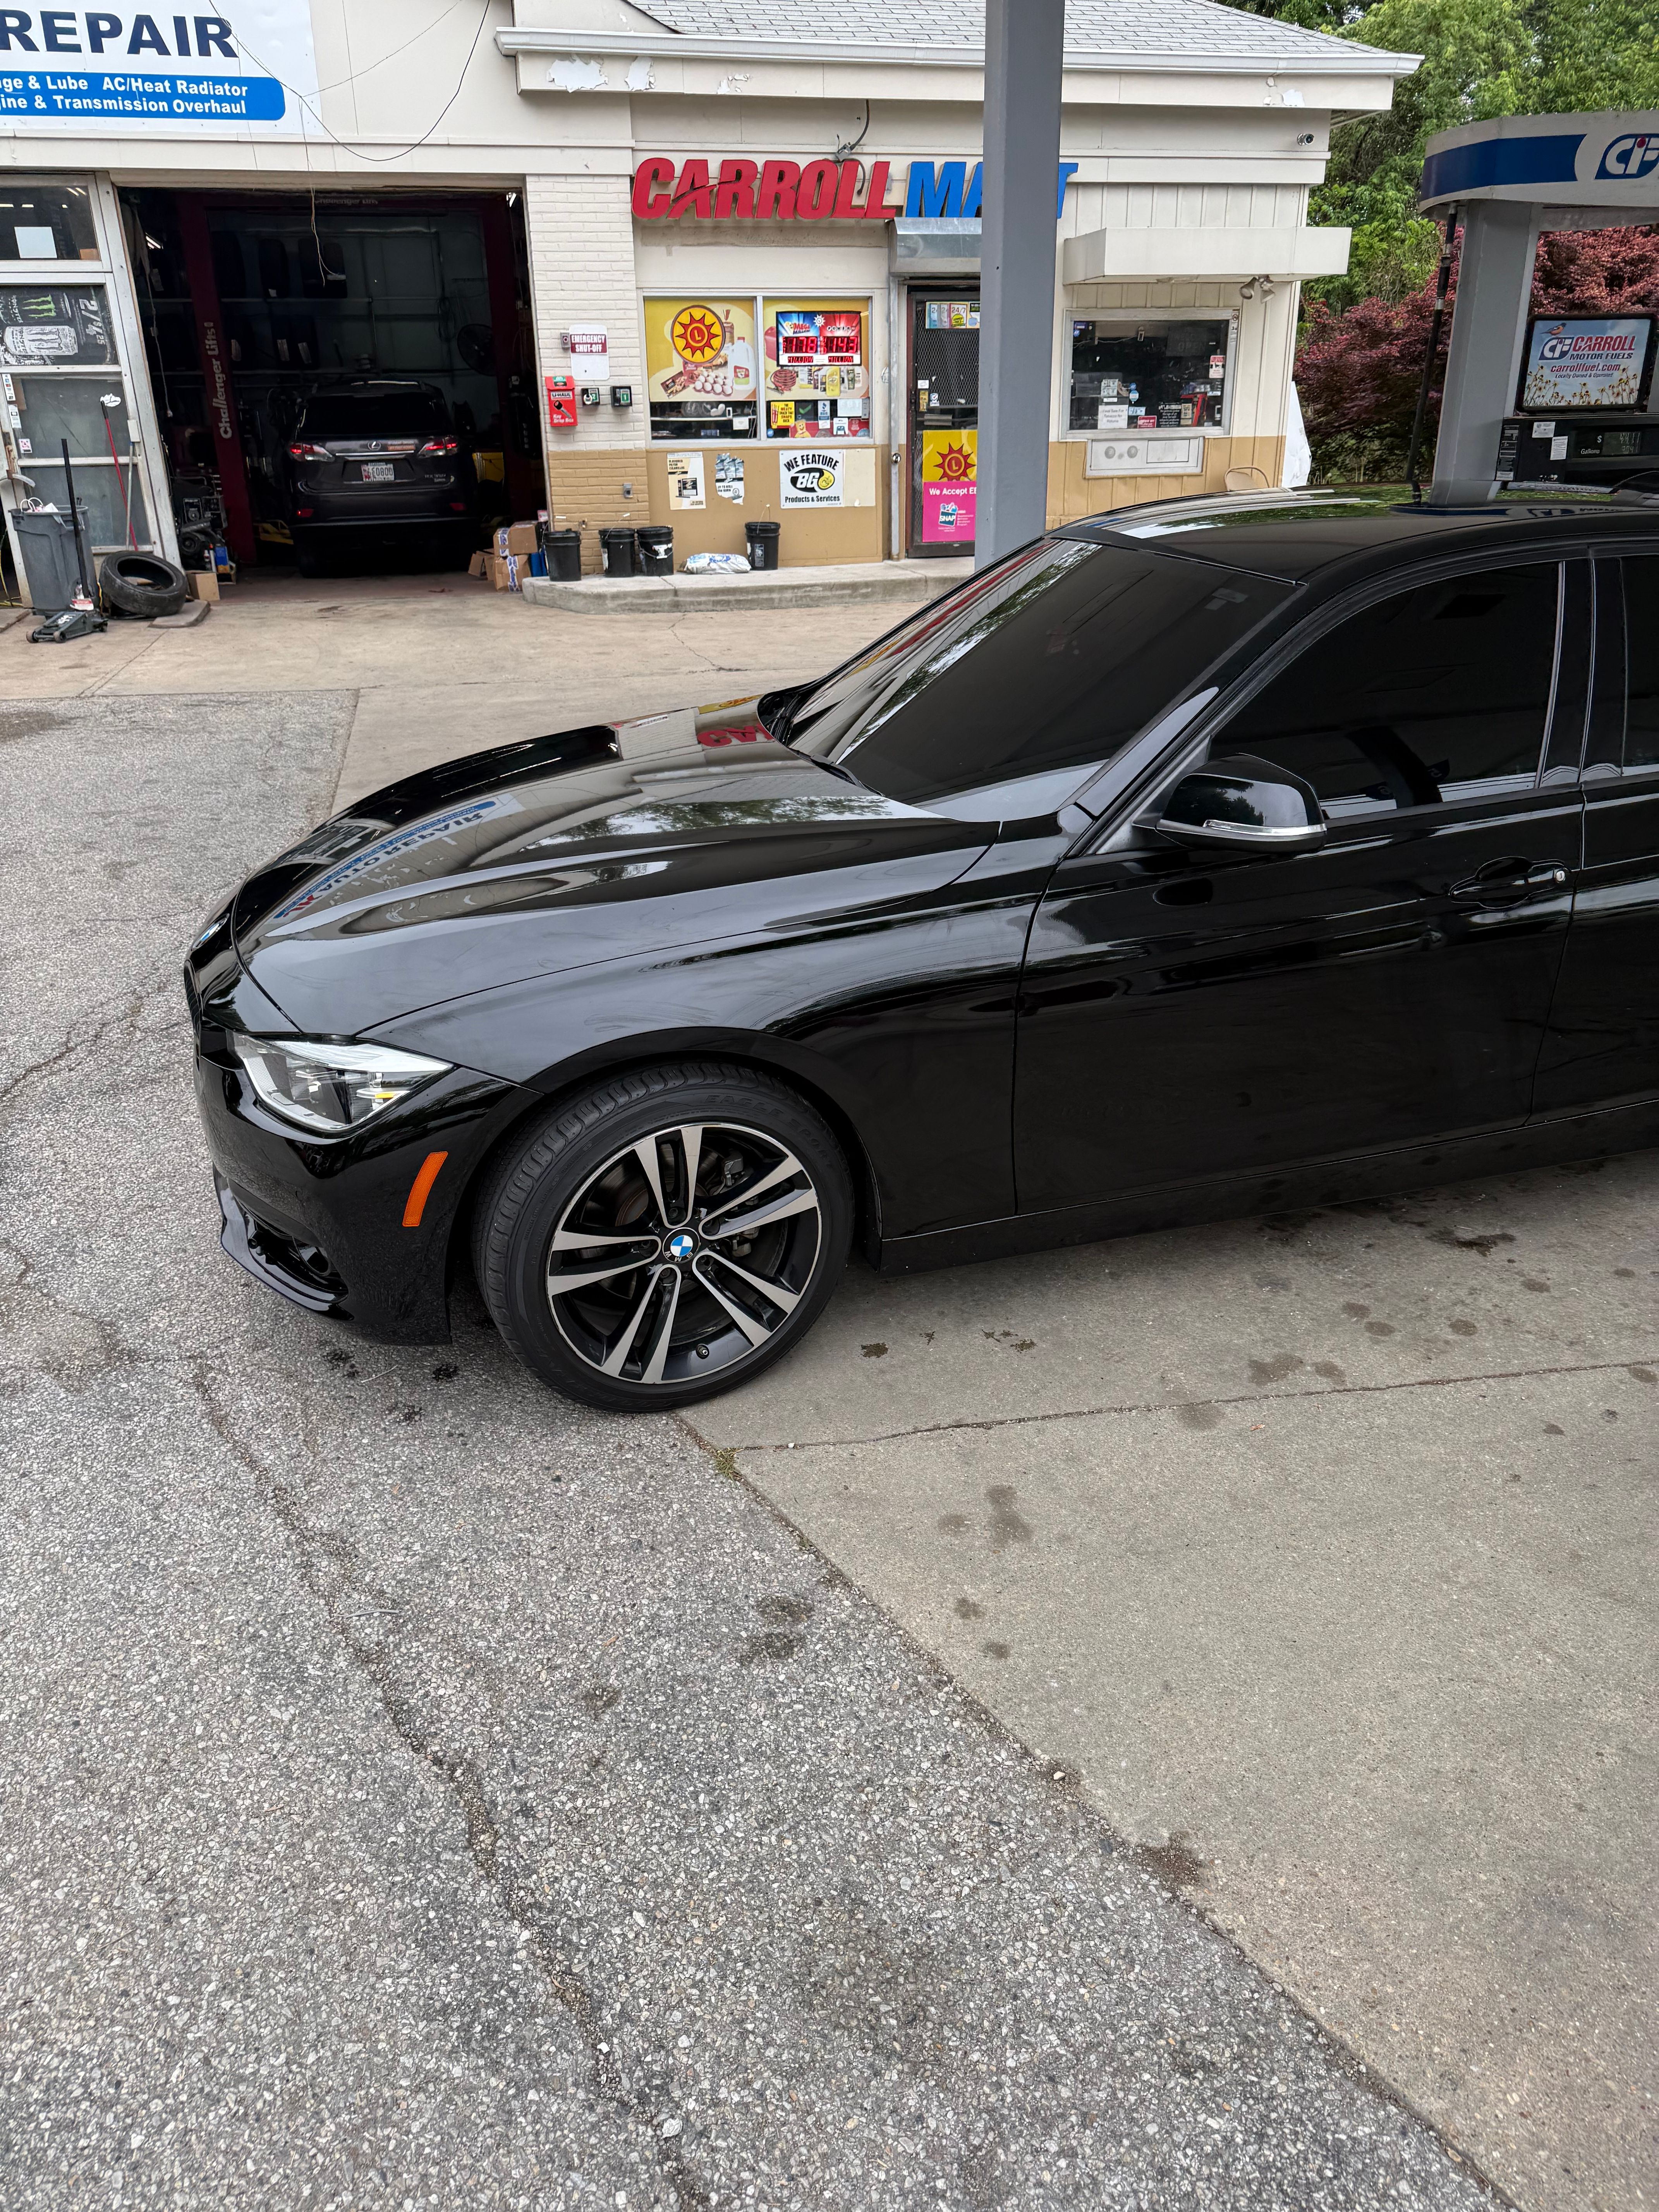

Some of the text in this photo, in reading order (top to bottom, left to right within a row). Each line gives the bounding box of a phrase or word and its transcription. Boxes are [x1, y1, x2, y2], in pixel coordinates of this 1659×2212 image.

[0, 9, 239, 58] REPAIR
[28, 76, 40, 89] &
[46, 76, 88, 90] Lube
[102, 77, 172, 93] AC/Heat
[177, 80, 248, 96] Radiator
[34, 95, 47, 109] &
[53, 95, 168, 112] Transmission
[173, 100, 246, 114] Overhaul
[632, 157, 896, 220] CARROLL
[204, 327, 218, 356] Lifts
[571, 335, 605, 343] EMERGENCY
[792, 337, 817, 353] 178
[833, 337, 857, 353] 143
[1572, 335, 1635, 352] CARROLL
[575, 344, 602, 352] SHUT-OFF
[1551, 362, 1621, 373] carrollfuel.com
[212, 358, 232, 439] Challenger
[784, 454, 839, 472] WE FEATURE
[796, 472, 820, 488] BG
[942, 488, 967, 496] Accept
[706, 1095, 784, 1115] EAGLE
[665, 1251, 693, 1262] BMW
